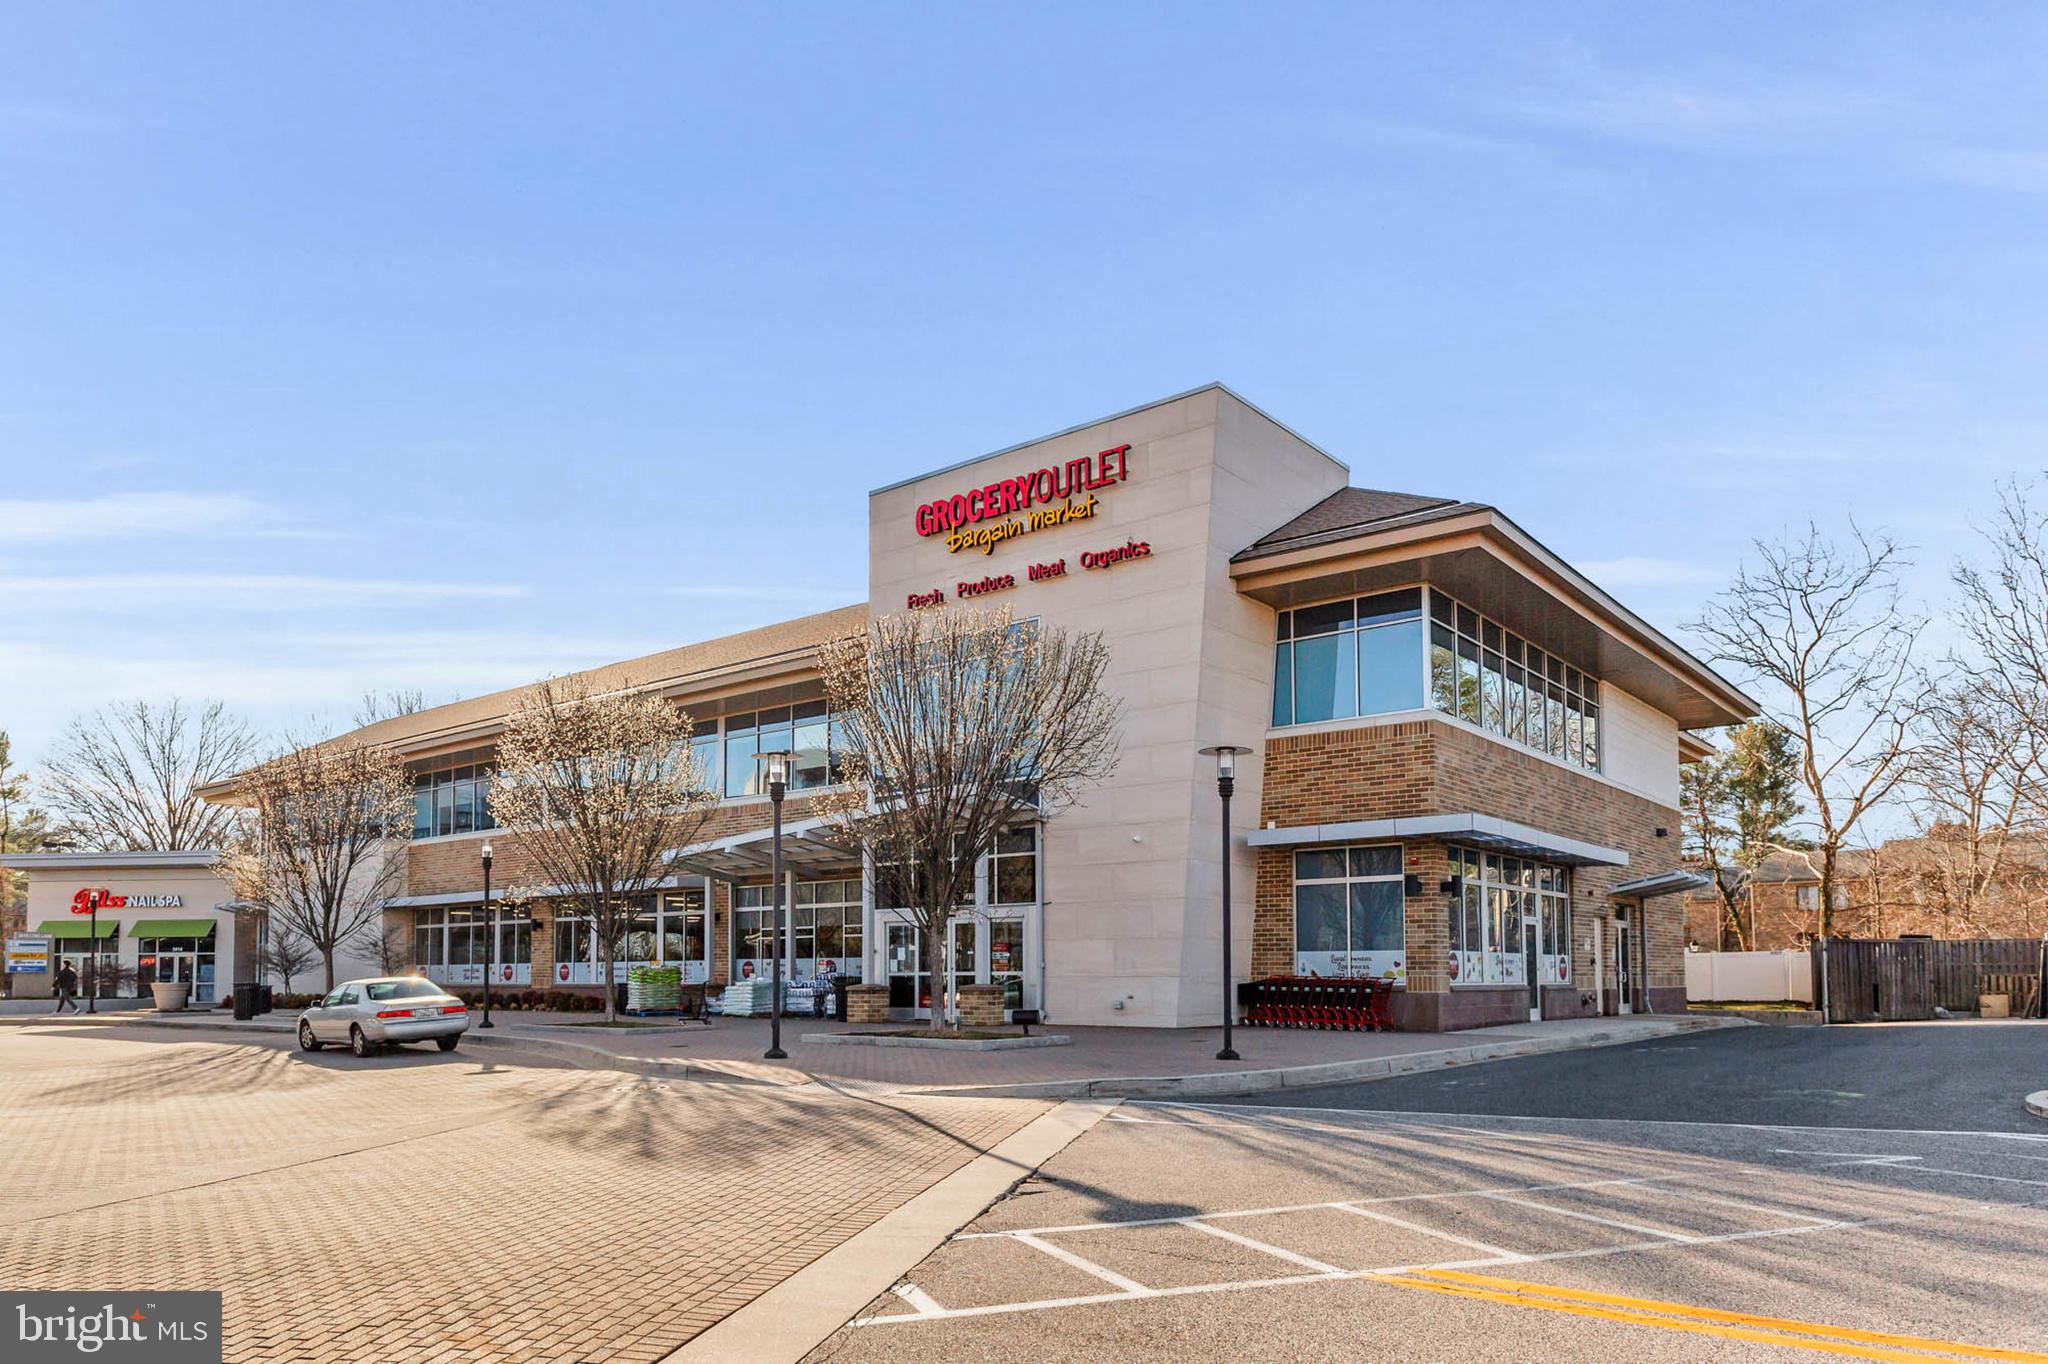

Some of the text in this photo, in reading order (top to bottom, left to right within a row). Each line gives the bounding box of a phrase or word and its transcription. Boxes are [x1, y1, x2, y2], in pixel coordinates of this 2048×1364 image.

[945, 493, 1099, 555] bargain market
[907, 539, 1151, 609] Fresh Produce Meat Organics
[127, 895, 157, 908] NAIL
[158, 895, 182, 908] SPA
